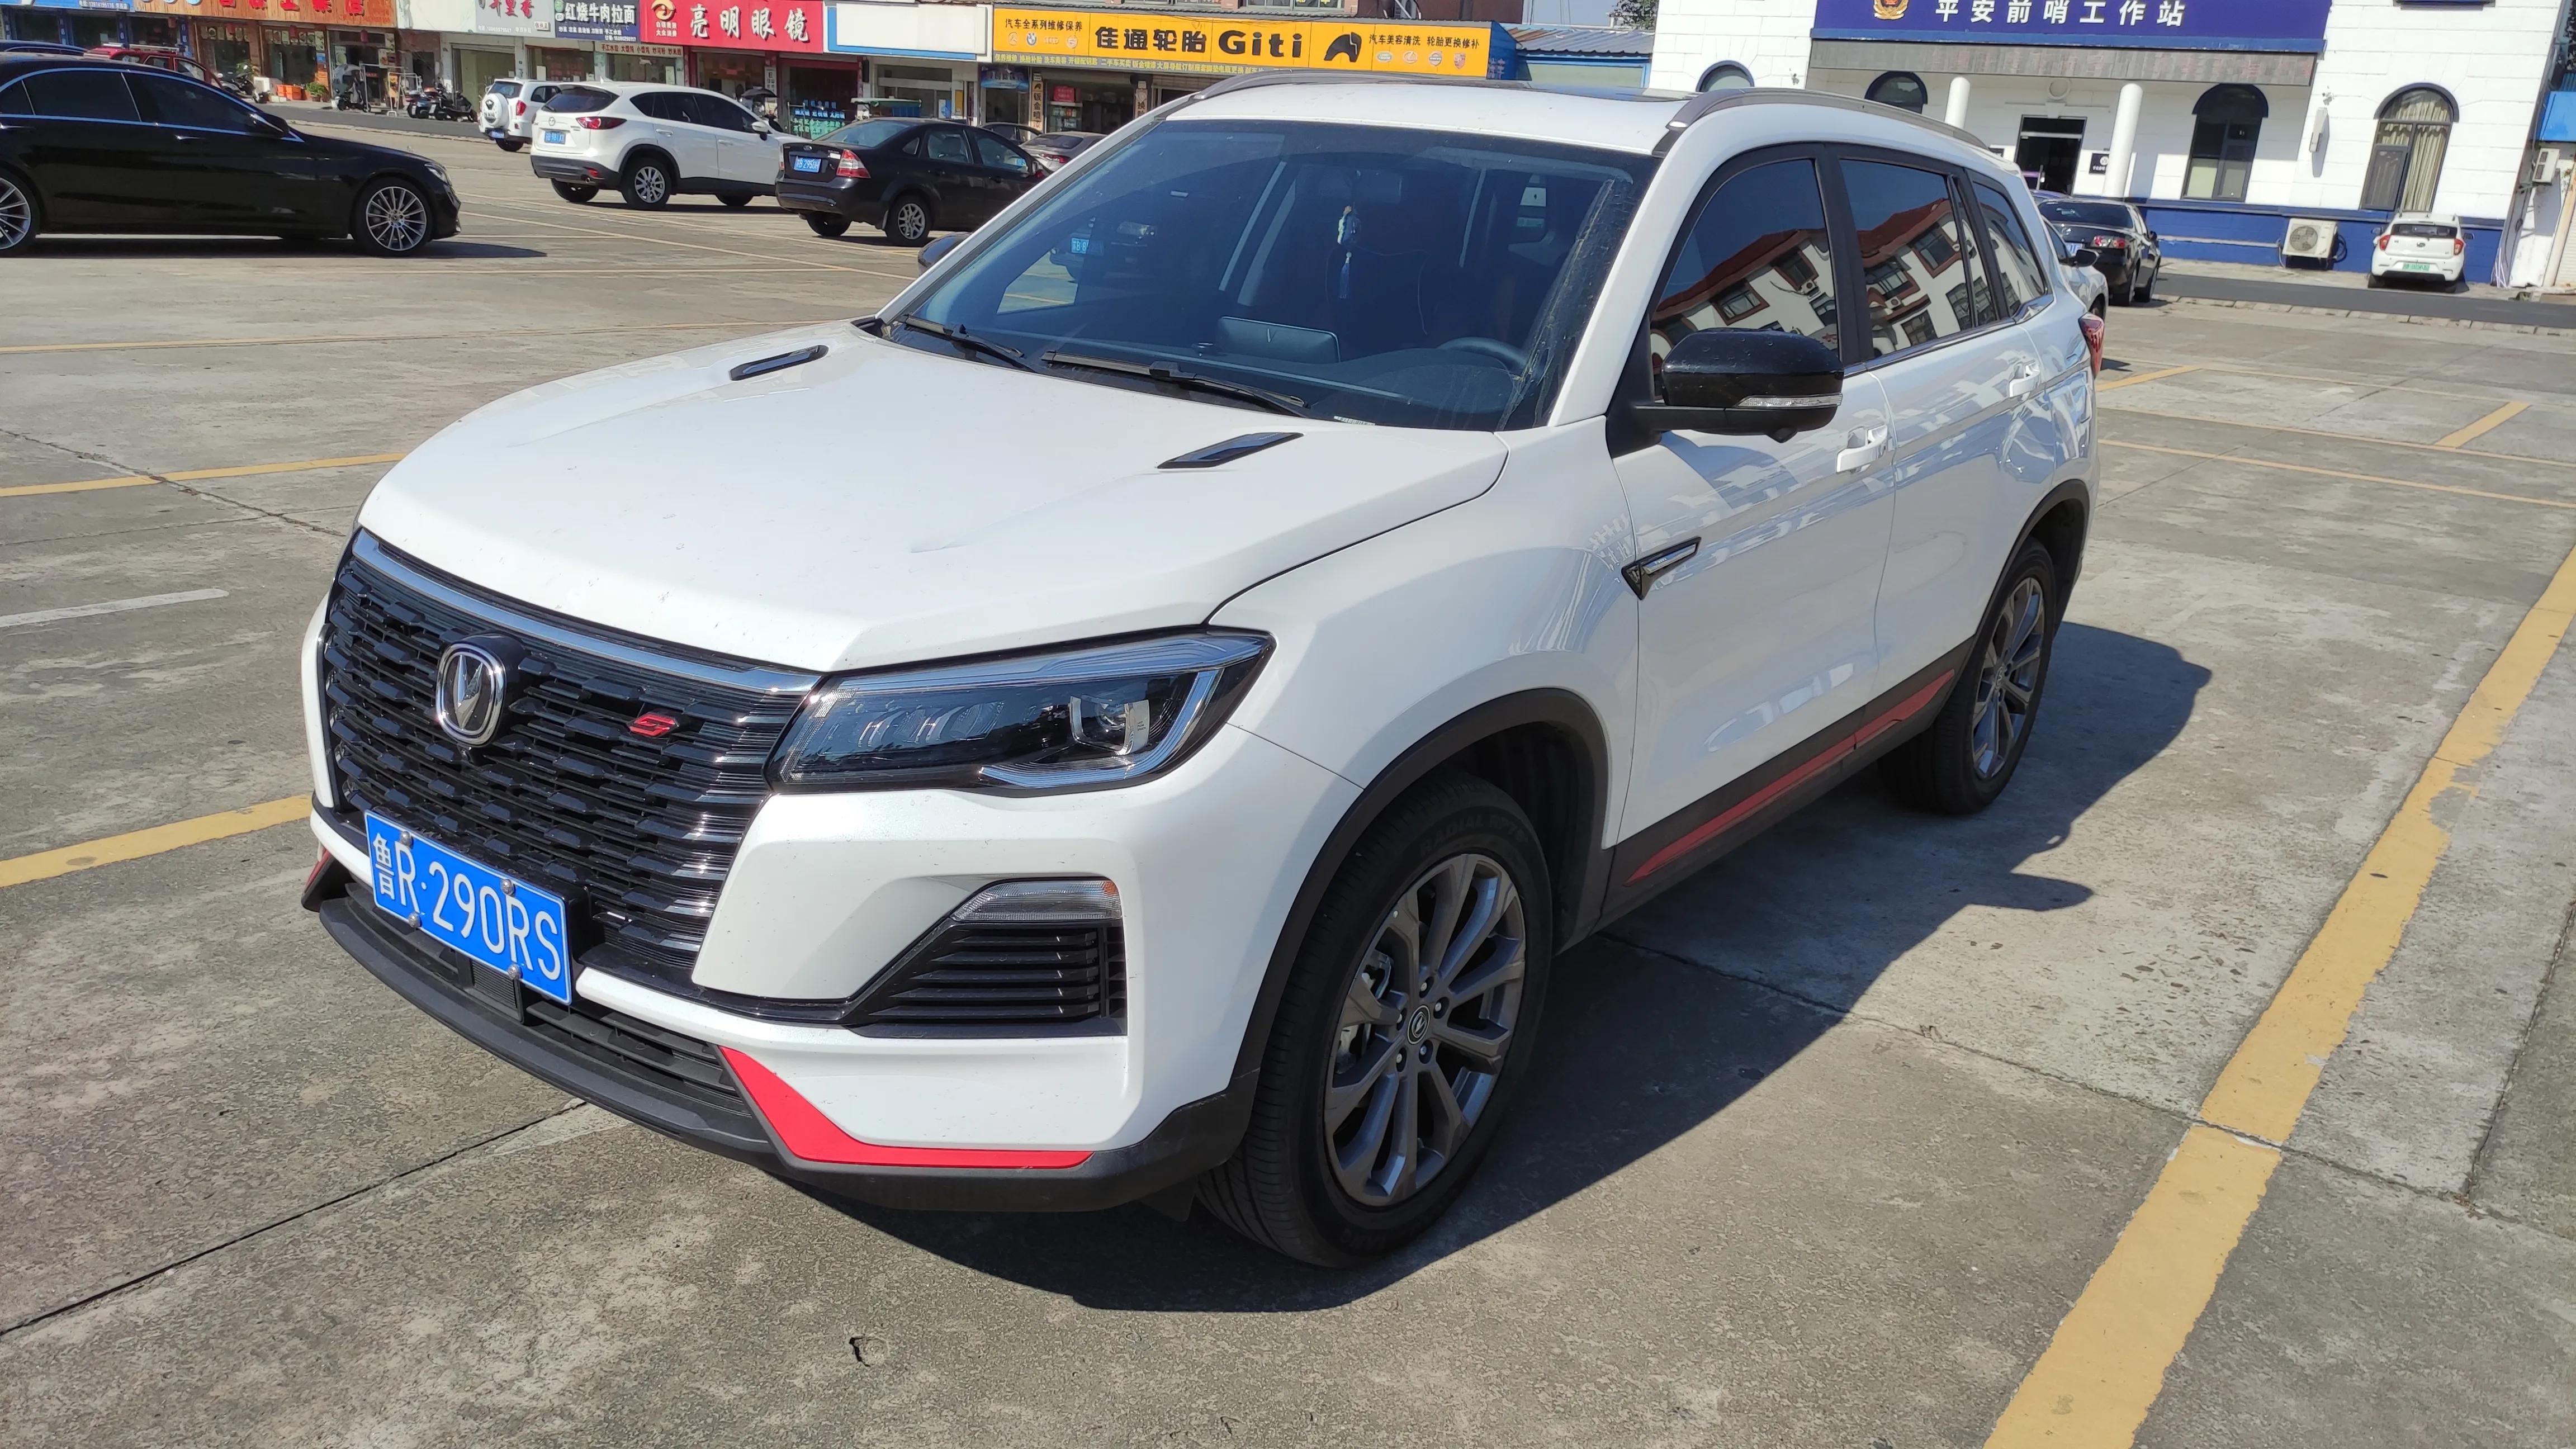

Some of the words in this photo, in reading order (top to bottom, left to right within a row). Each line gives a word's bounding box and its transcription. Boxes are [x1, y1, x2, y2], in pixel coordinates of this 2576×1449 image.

[565, 2, 636, 24] 红烧牛肉拉面
[690, 3, 811, 42] 亮明眼镜
[1005, 18, 1082, 31] 汽车全系列维修保养
[1935, 0, 2185, 27] 平安前哨工作站
[1095, 27, 1207, 53] 佳通轮胎
[1218, 30, 1303, 58] Giti
[1369, 34, 1420, 46] 汽车美容清洗
[1427, 36, 1479, 49] 轮胎更换修补
[372, 832, 561, 981] 鲁R·290RS
